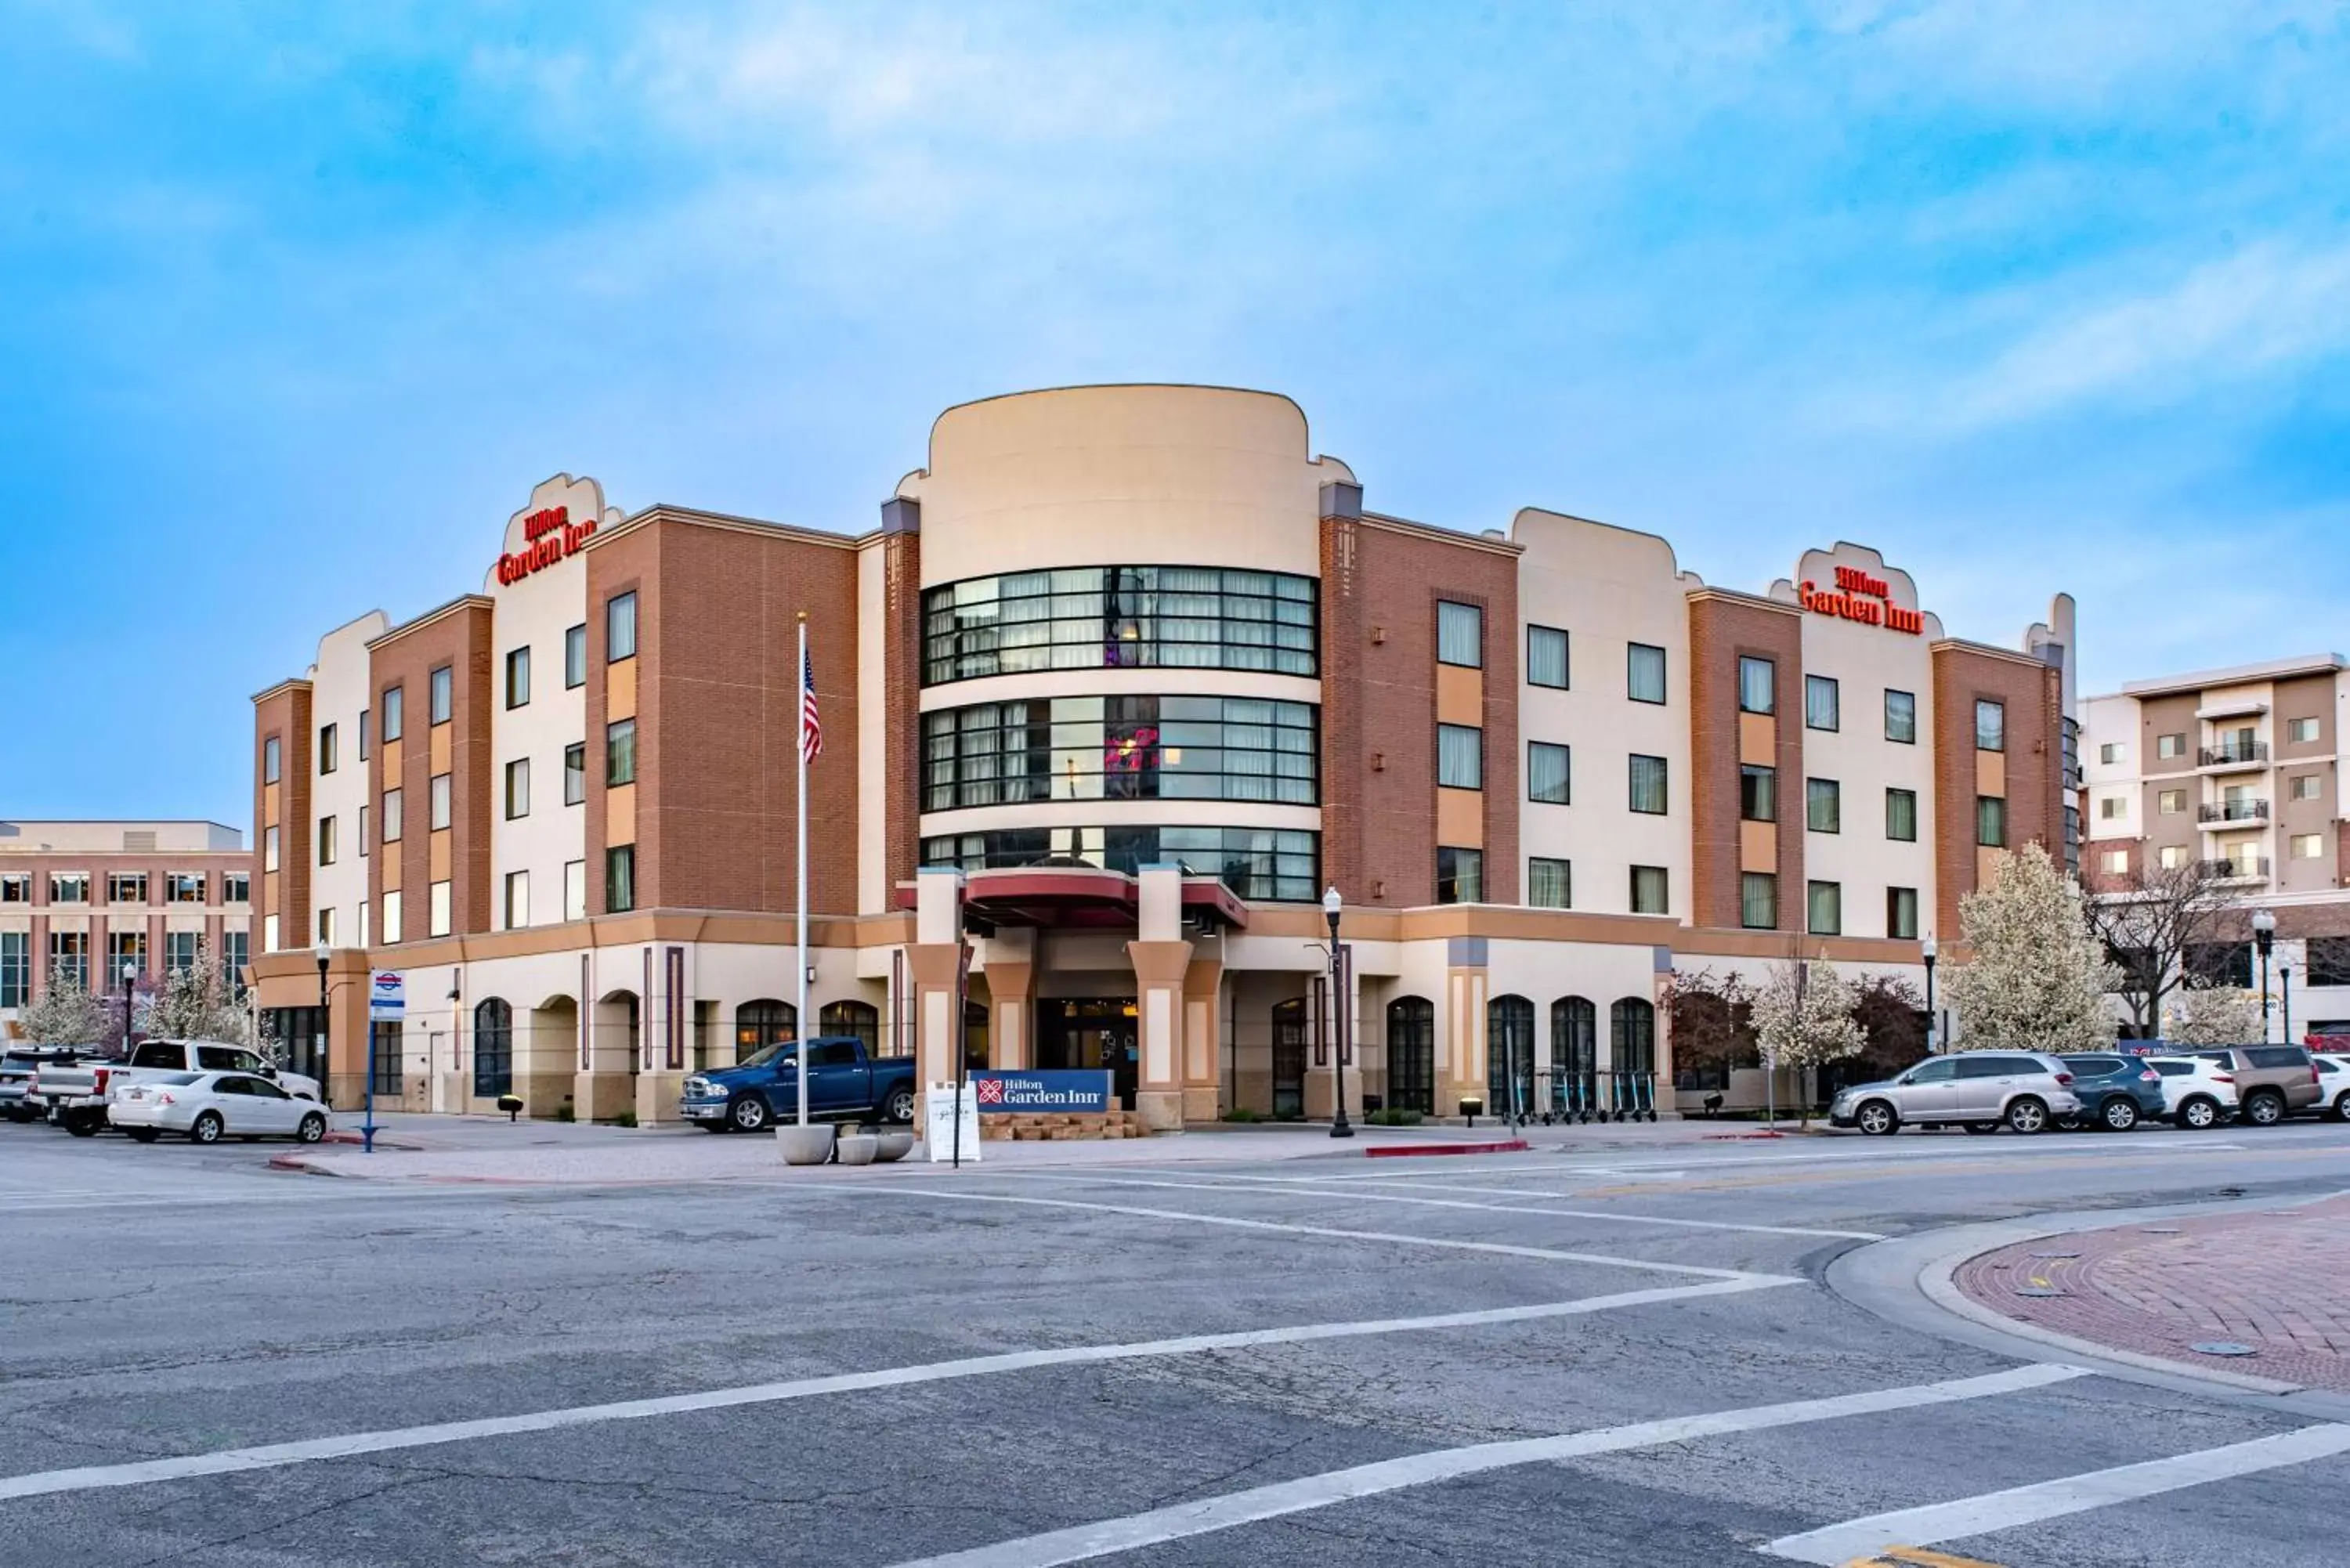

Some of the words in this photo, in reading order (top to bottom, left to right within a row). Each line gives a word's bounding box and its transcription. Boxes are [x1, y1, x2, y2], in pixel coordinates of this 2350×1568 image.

[524, 506, 568, 541] Hilton
[497, 537, 562, 587] Garden
[1835, 566, 1889, 598] Hilton
[1799, 581, 1881, 626] Garden
[1883, 599, 1925, 635] Inn
[1003, 1089, 1065, 1104] Garden
[1068, 1089, 1098, 1104] Inn
[1005, 1078, 1043, 1089] Hilton
